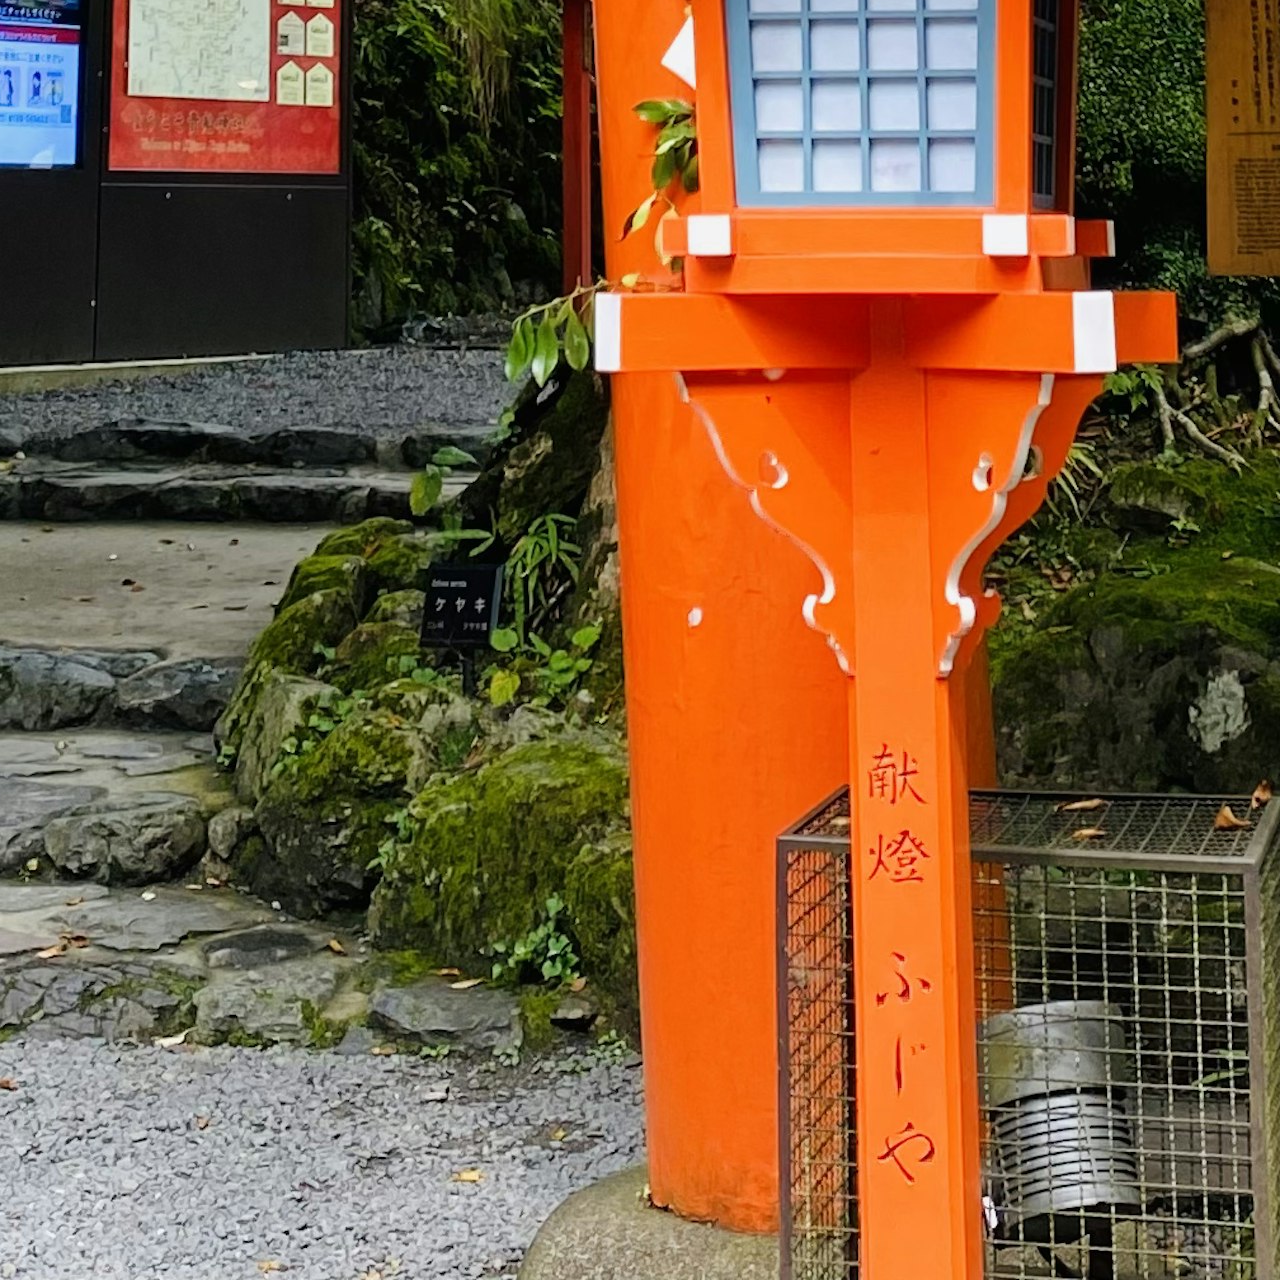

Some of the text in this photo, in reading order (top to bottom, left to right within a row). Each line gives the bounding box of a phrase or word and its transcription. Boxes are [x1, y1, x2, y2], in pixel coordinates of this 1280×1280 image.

[435, 597, 487, 614] ケヤキ
[866, 741, 936, 1186] 献燈 ふじや
